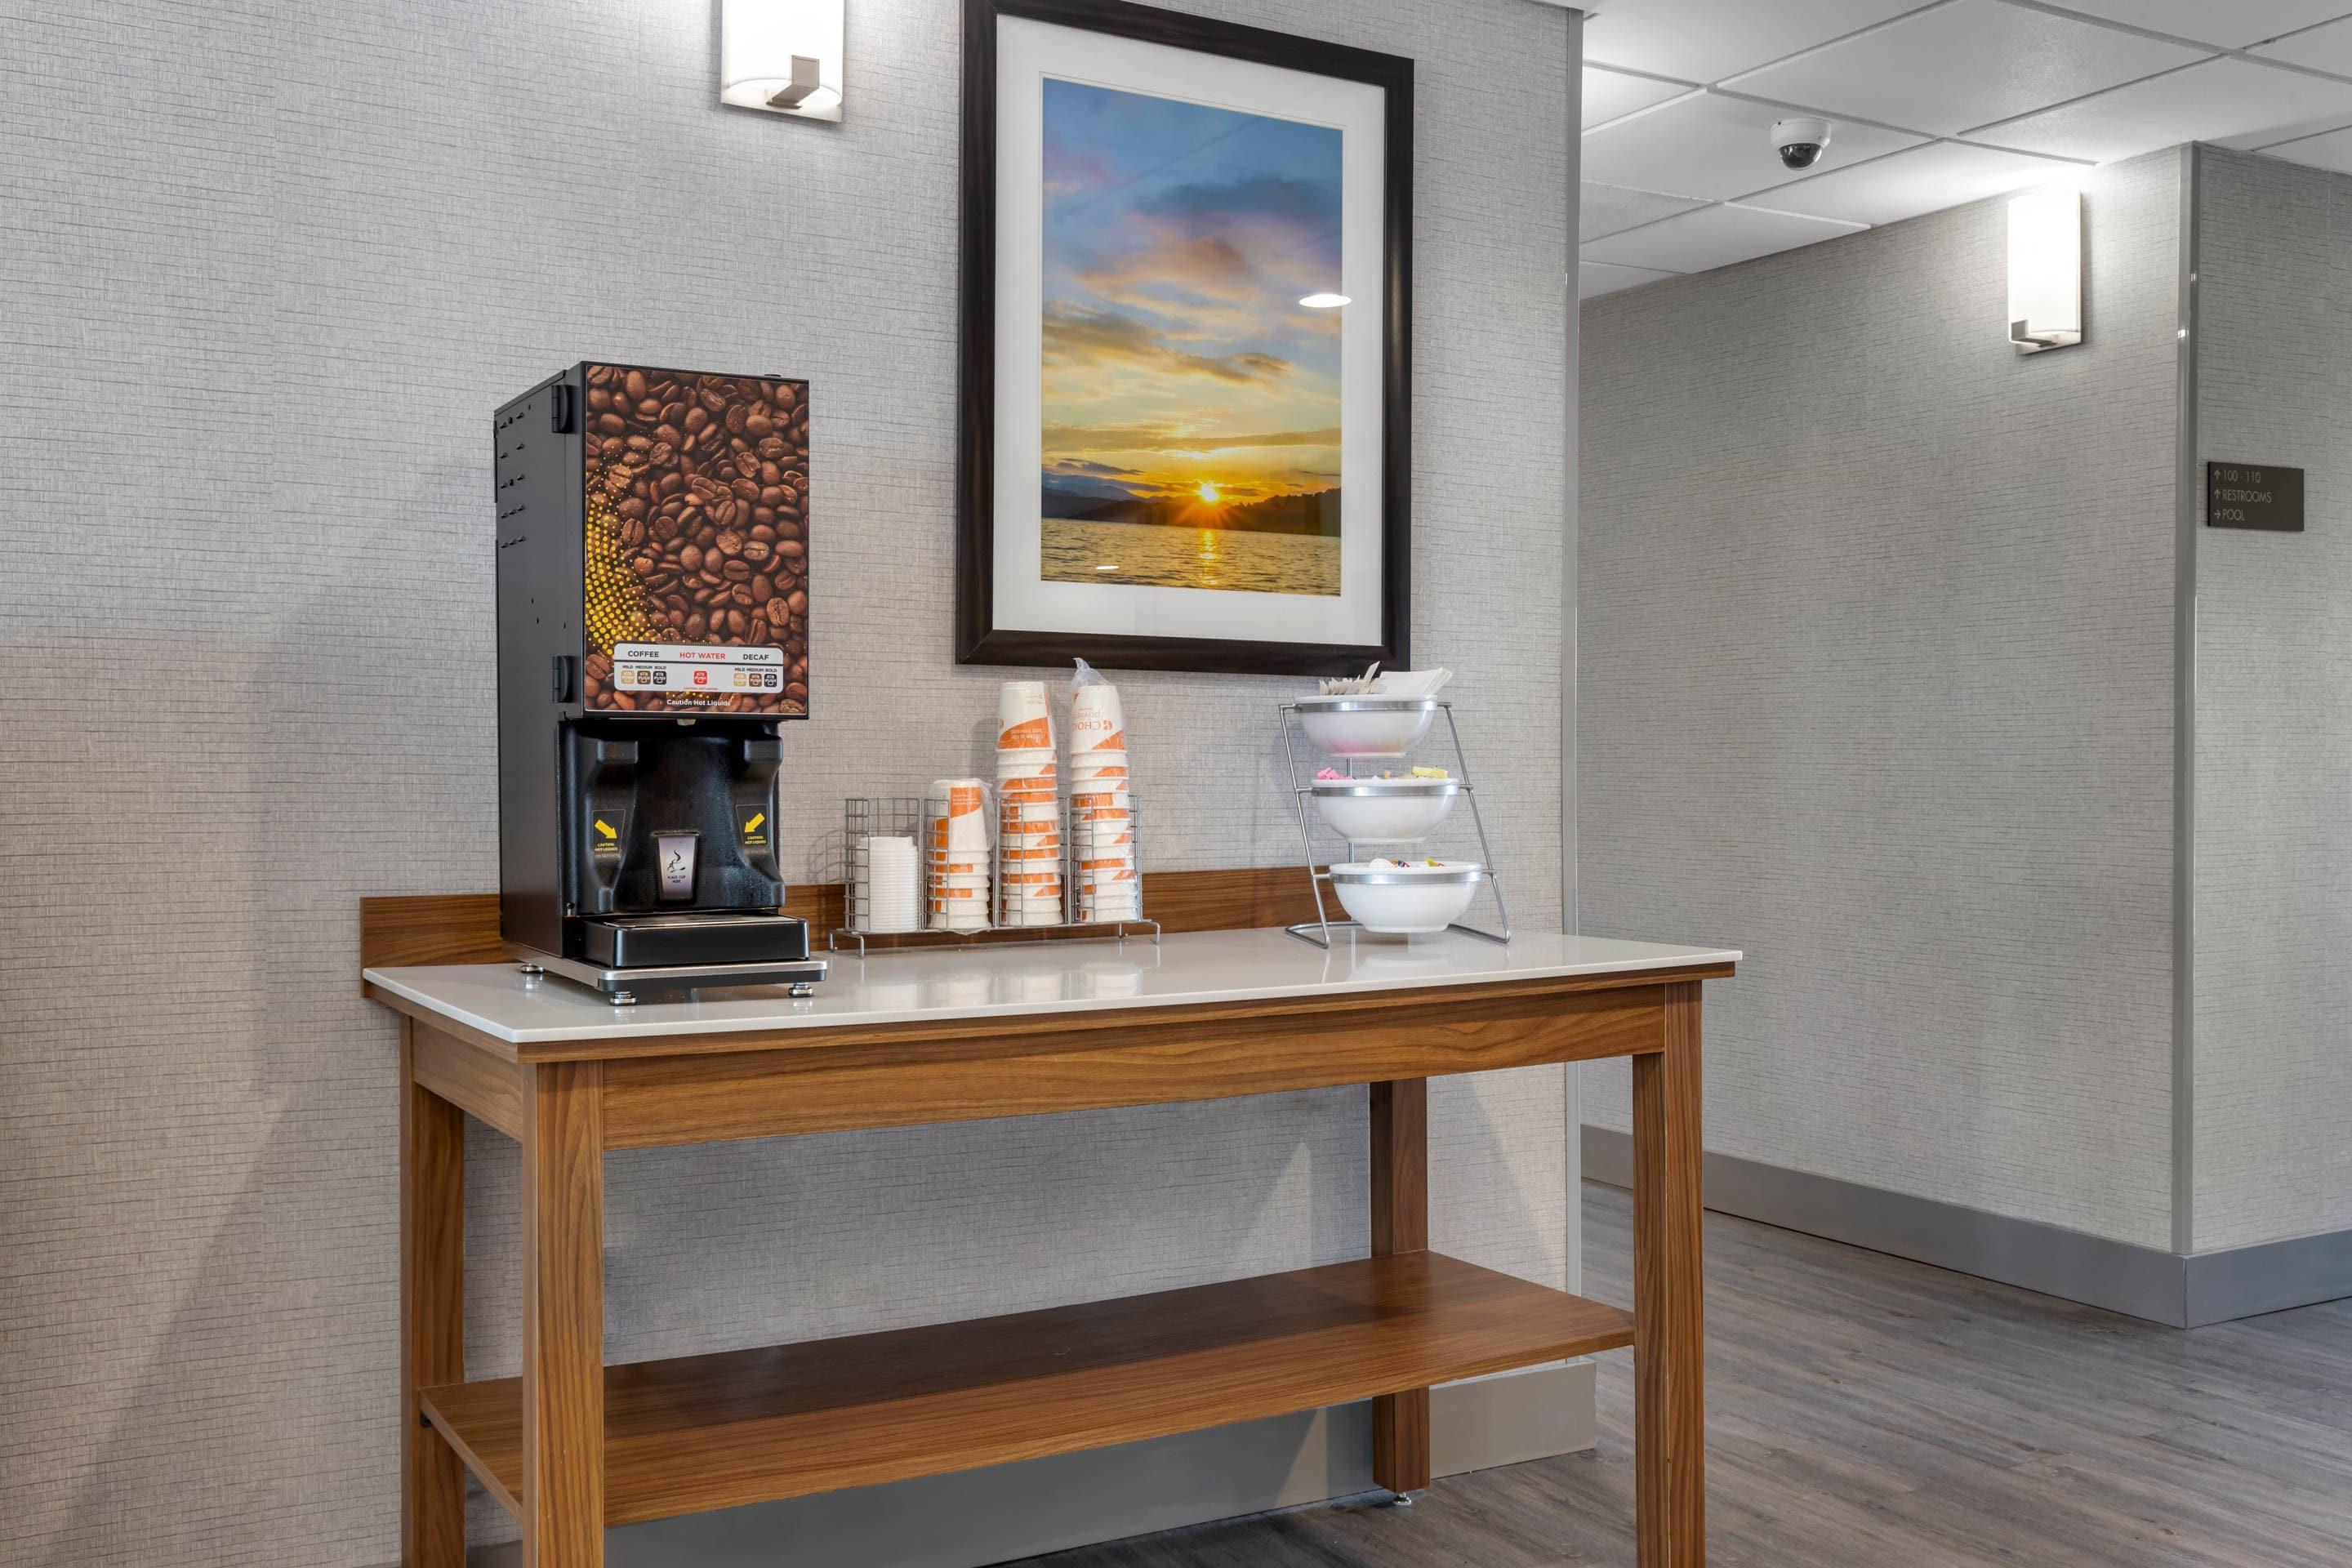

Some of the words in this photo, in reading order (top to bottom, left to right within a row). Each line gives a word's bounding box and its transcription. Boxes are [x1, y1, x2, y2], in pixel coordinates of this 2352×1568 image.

[2223, 470, 2238, 482] 100
[2246, 471, 2261, 483] 110
[2222, 488, 2272, 503] RESTROOMS
[2222, 508, 2246, 521] POOL
[627, 650, 660, 658] COFFEE
